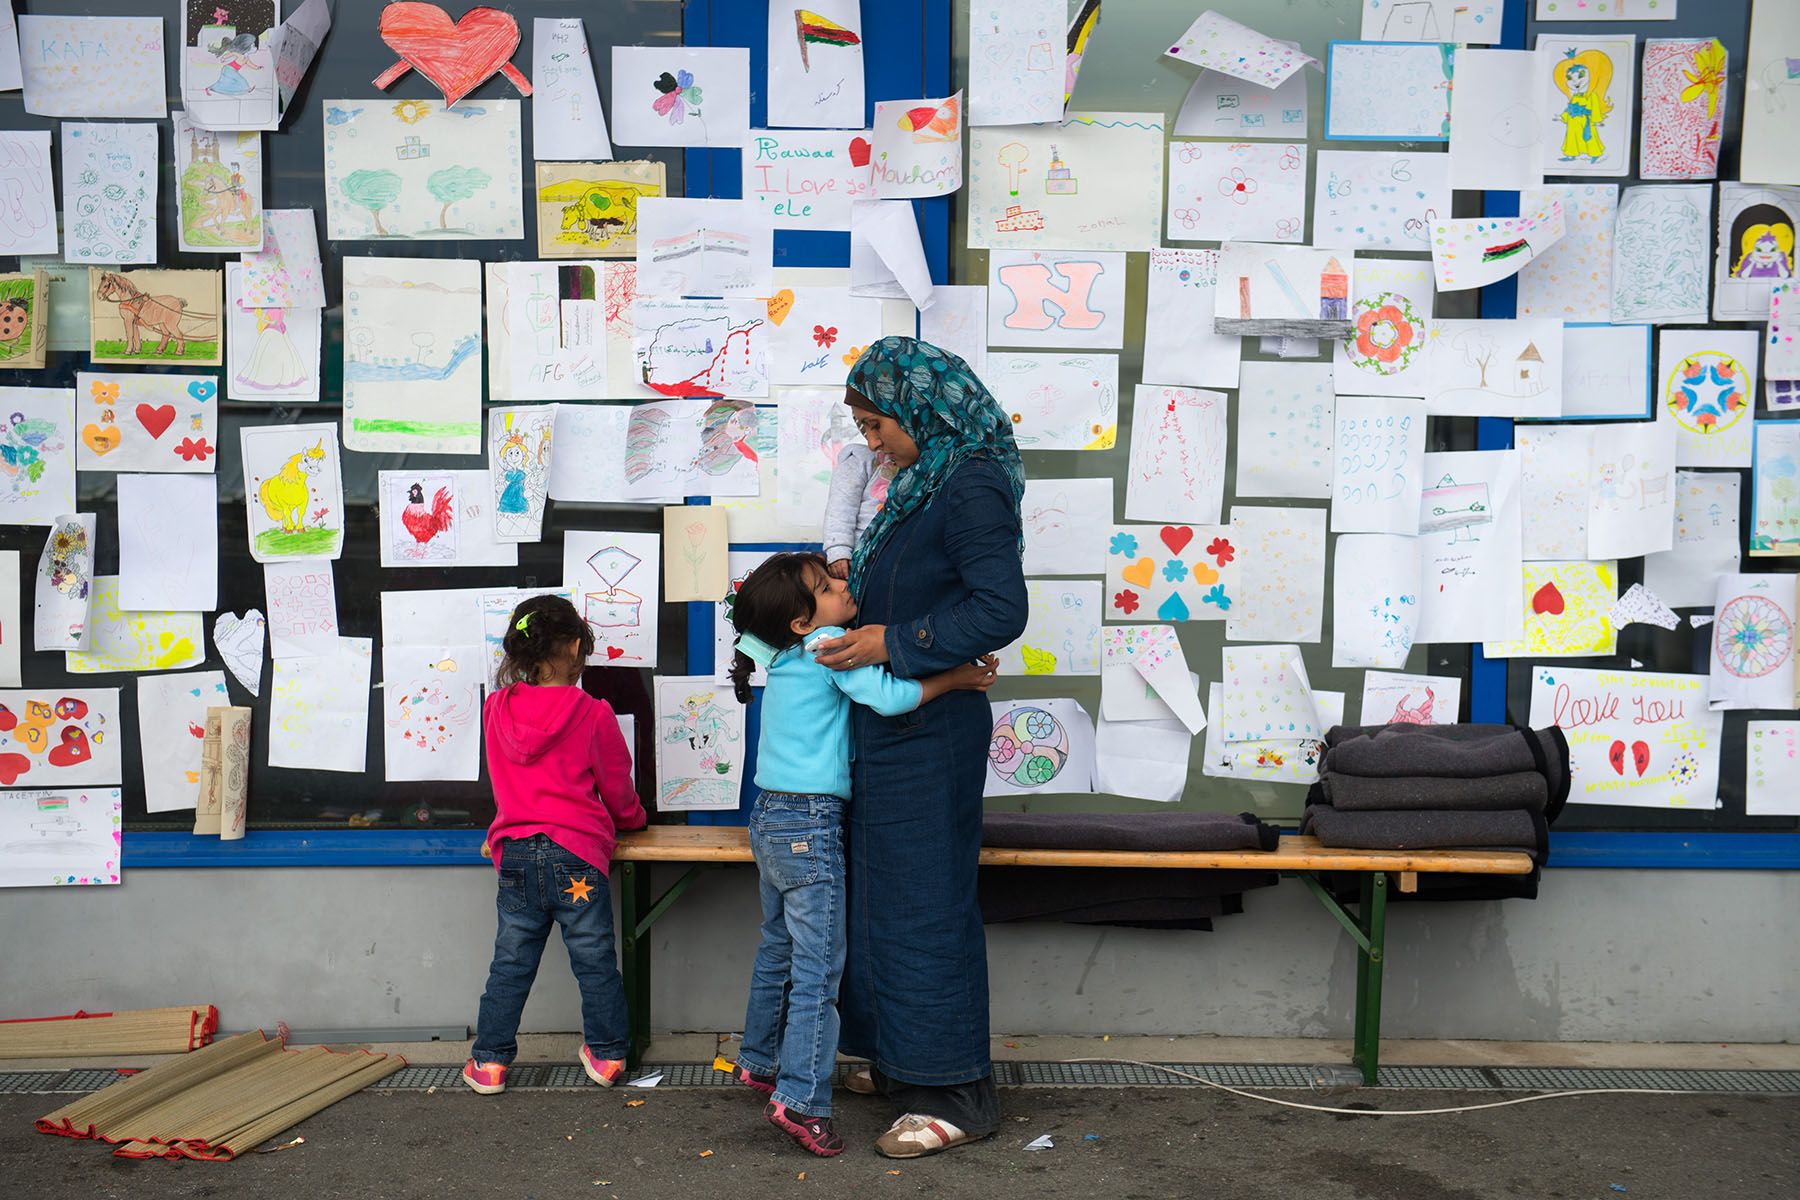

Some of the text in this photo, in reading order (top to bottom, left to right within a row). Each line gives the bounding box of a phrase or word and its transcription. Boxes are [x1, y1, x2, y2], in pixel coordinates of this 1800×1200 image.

[41, 40, 110, 62] KAFA
[754, 165, 867, 195] I Love yo
[1356, 268, 1427, 288] FATMA
[998, 260, 1105, 332] N
[528, 362, 565, 384] AFG
[126, 377, 189, 398] FATMA
